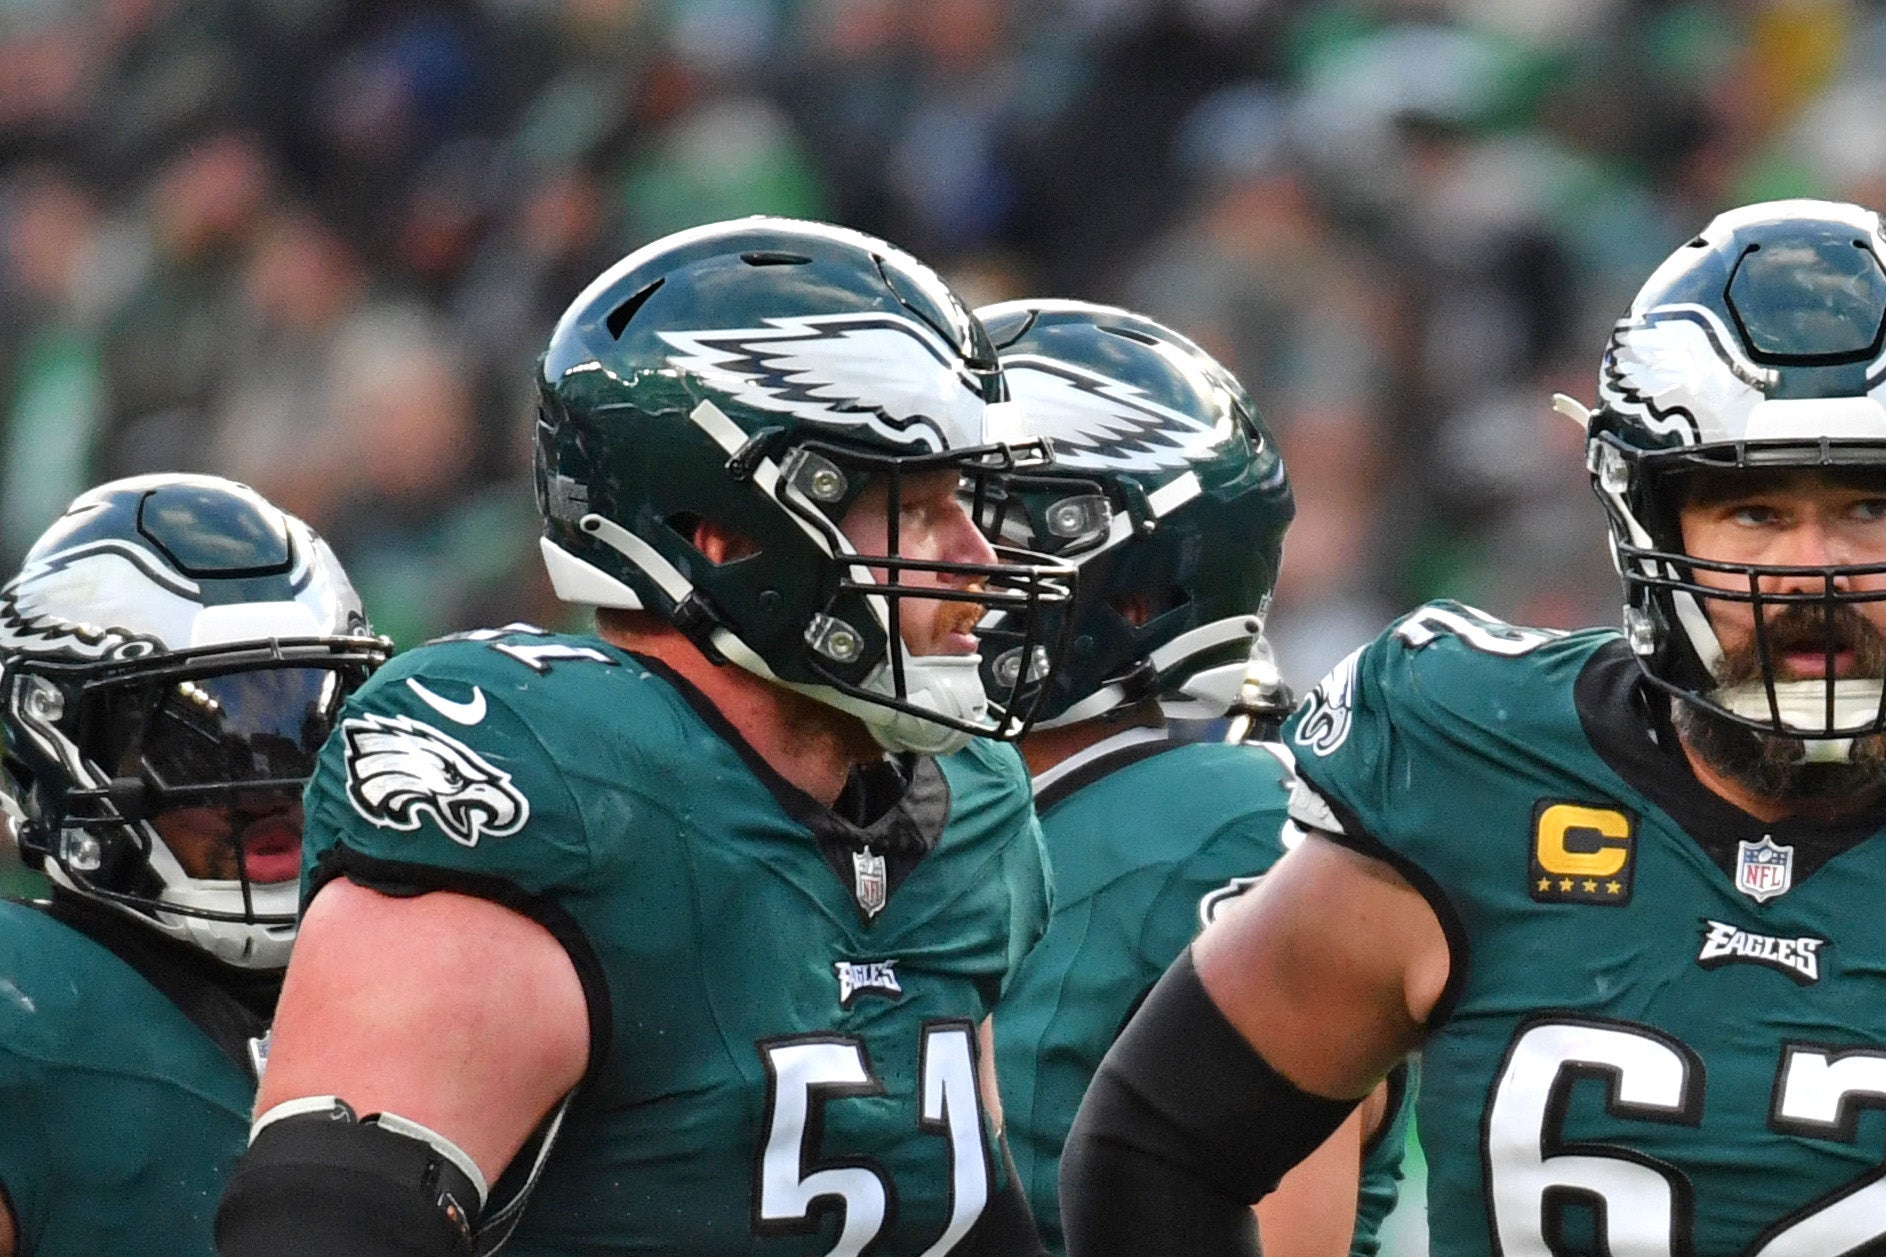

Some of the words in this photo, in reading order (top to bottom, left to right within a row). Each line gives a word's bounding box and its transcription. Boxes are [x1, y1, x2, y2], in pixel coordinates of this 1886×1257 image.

[1536, 803, 1630, 877] C
[1744, 864, 1782, 889] NFL
[1699, 919, 1824, 981] EAGLES
[834, 958, 903, 1003] EAGLES
